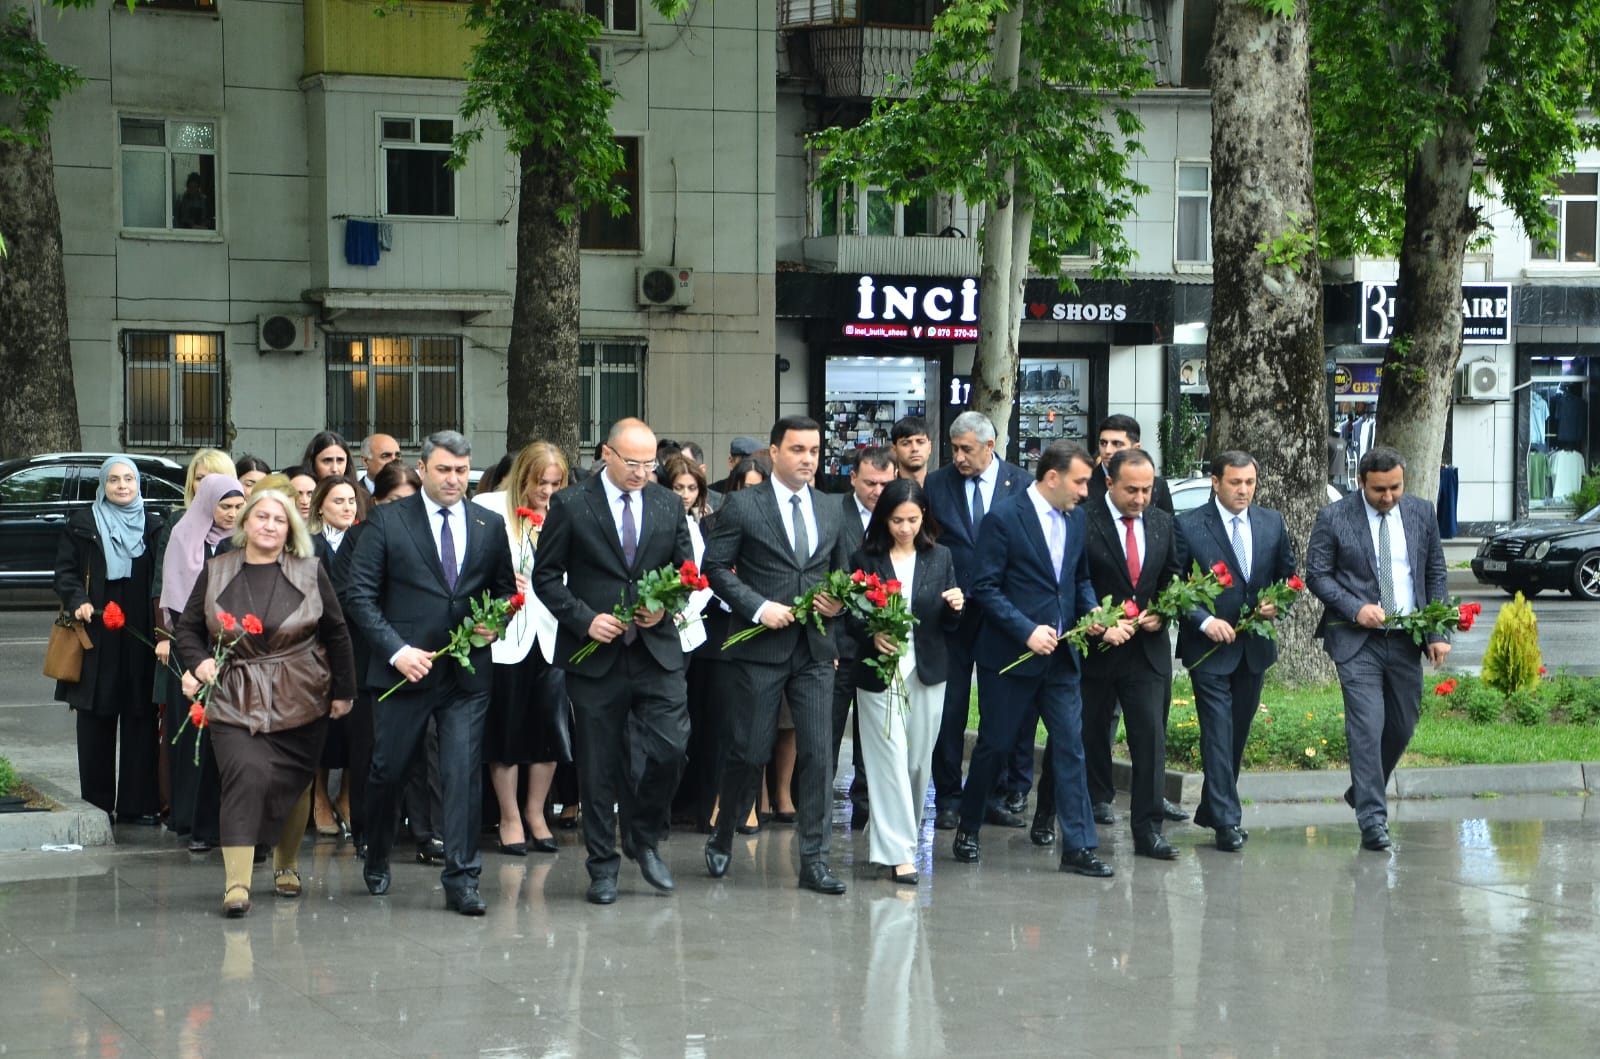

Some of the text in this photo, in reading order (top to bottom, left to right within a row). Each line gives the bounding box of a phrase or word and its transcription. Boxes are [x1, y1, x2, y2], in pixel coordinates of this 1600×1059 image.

[1052, 303, 1127, 321] SHOES
[937, 328, 951, 337] 070
[1352, 382, 1379, 393] GEY
